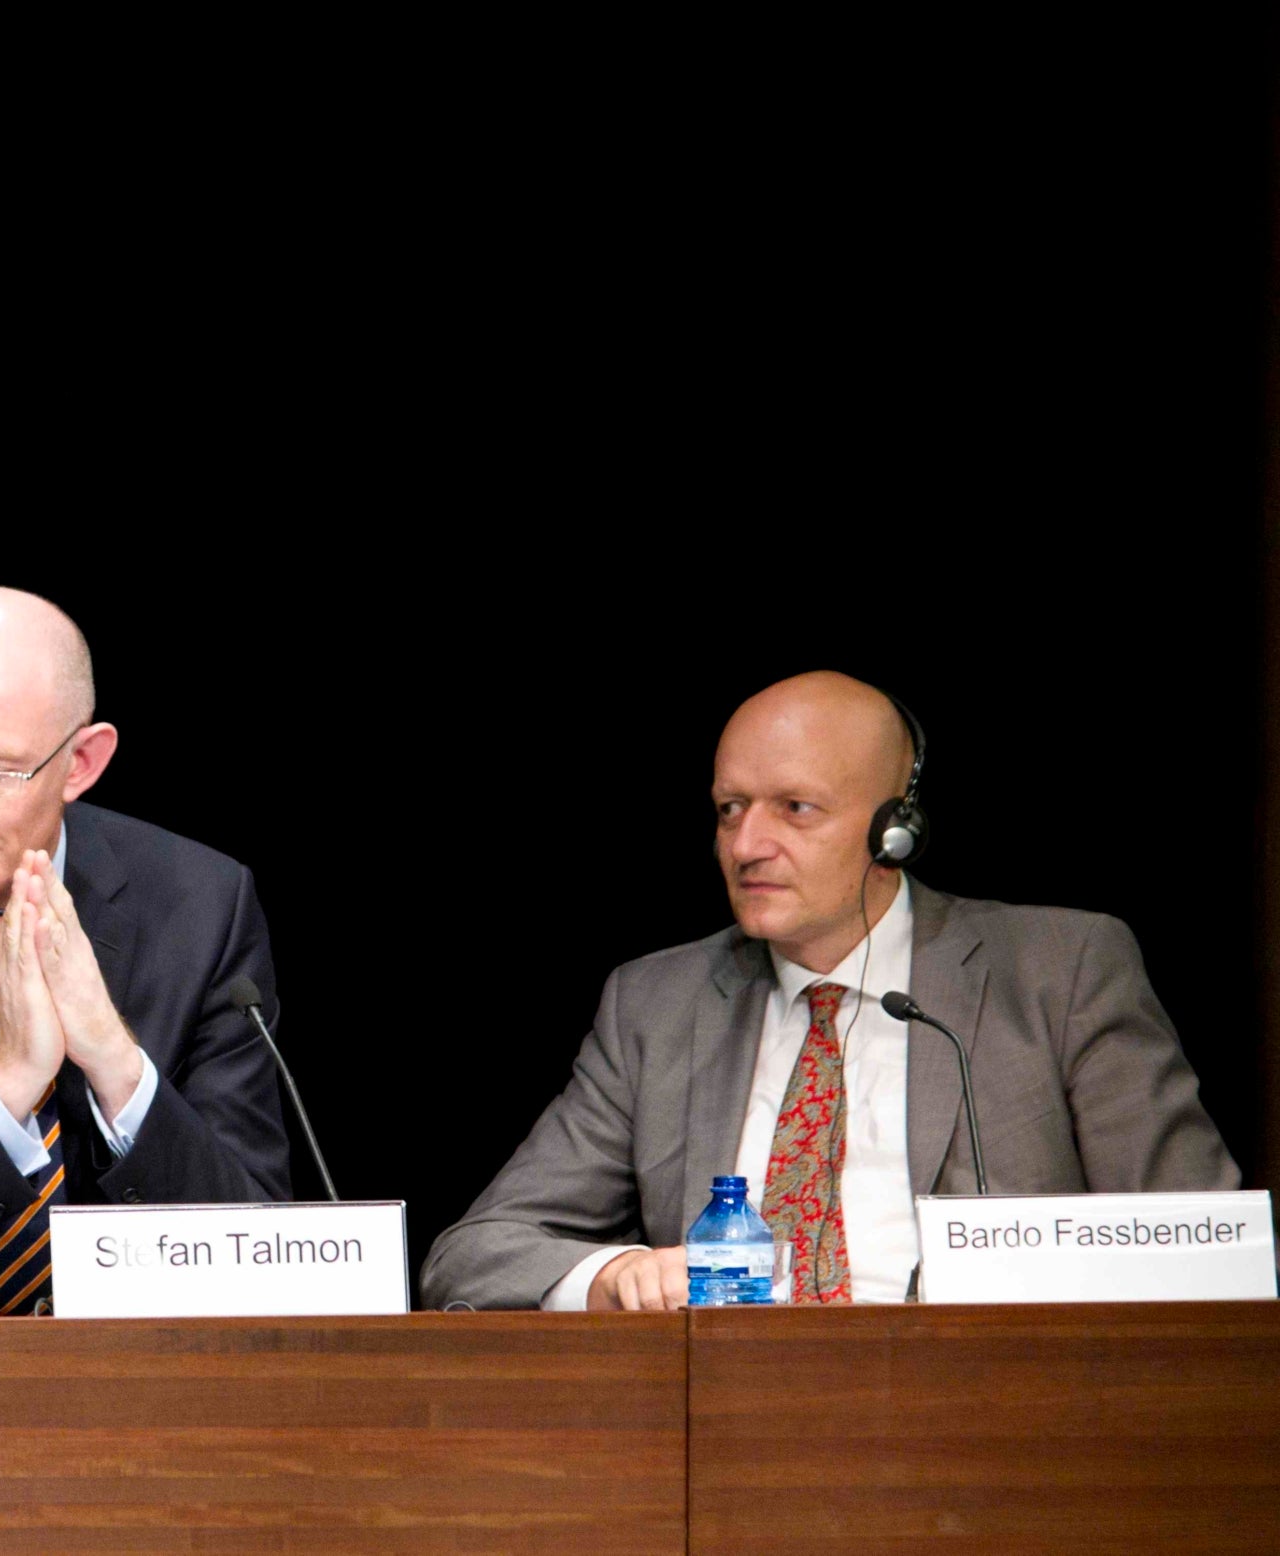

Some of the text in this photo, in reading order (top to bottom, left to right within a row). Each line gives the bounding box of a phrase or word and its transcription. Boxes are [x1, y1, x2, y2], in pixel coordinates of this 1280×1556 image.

[226, 1232, 362, 1265] Talmon
[947, 1217, 1247, 1249] Bardo Fassbender
